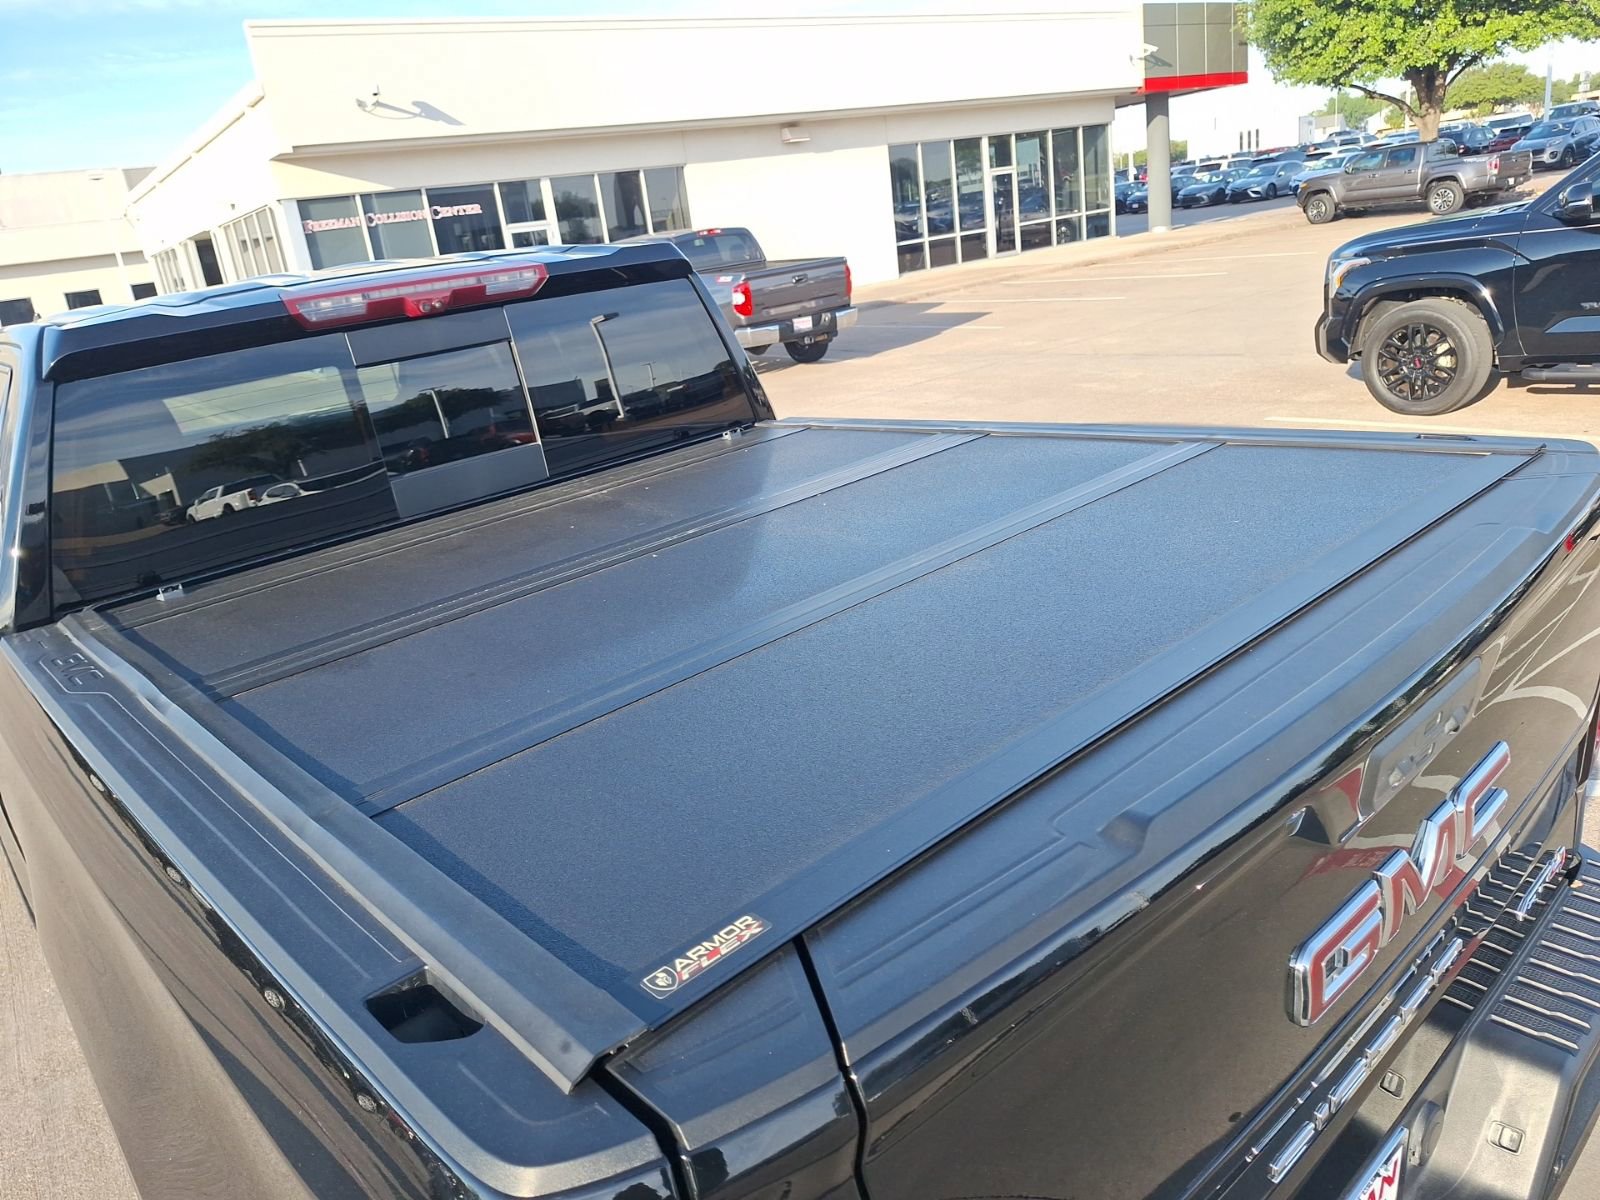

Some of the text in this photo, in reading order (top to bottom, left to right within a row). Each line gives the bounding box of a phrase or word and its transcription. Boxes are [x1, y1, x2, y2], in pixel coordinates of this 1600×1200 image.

[366, 210, 428, 226] COLLISION
[431, 203, 482, 219] CENTER
[1284, 740, 1510, 1026] GMC
[675, 915, 758, 971] ARMOR
[677, 920, 764, 981] FLEX
